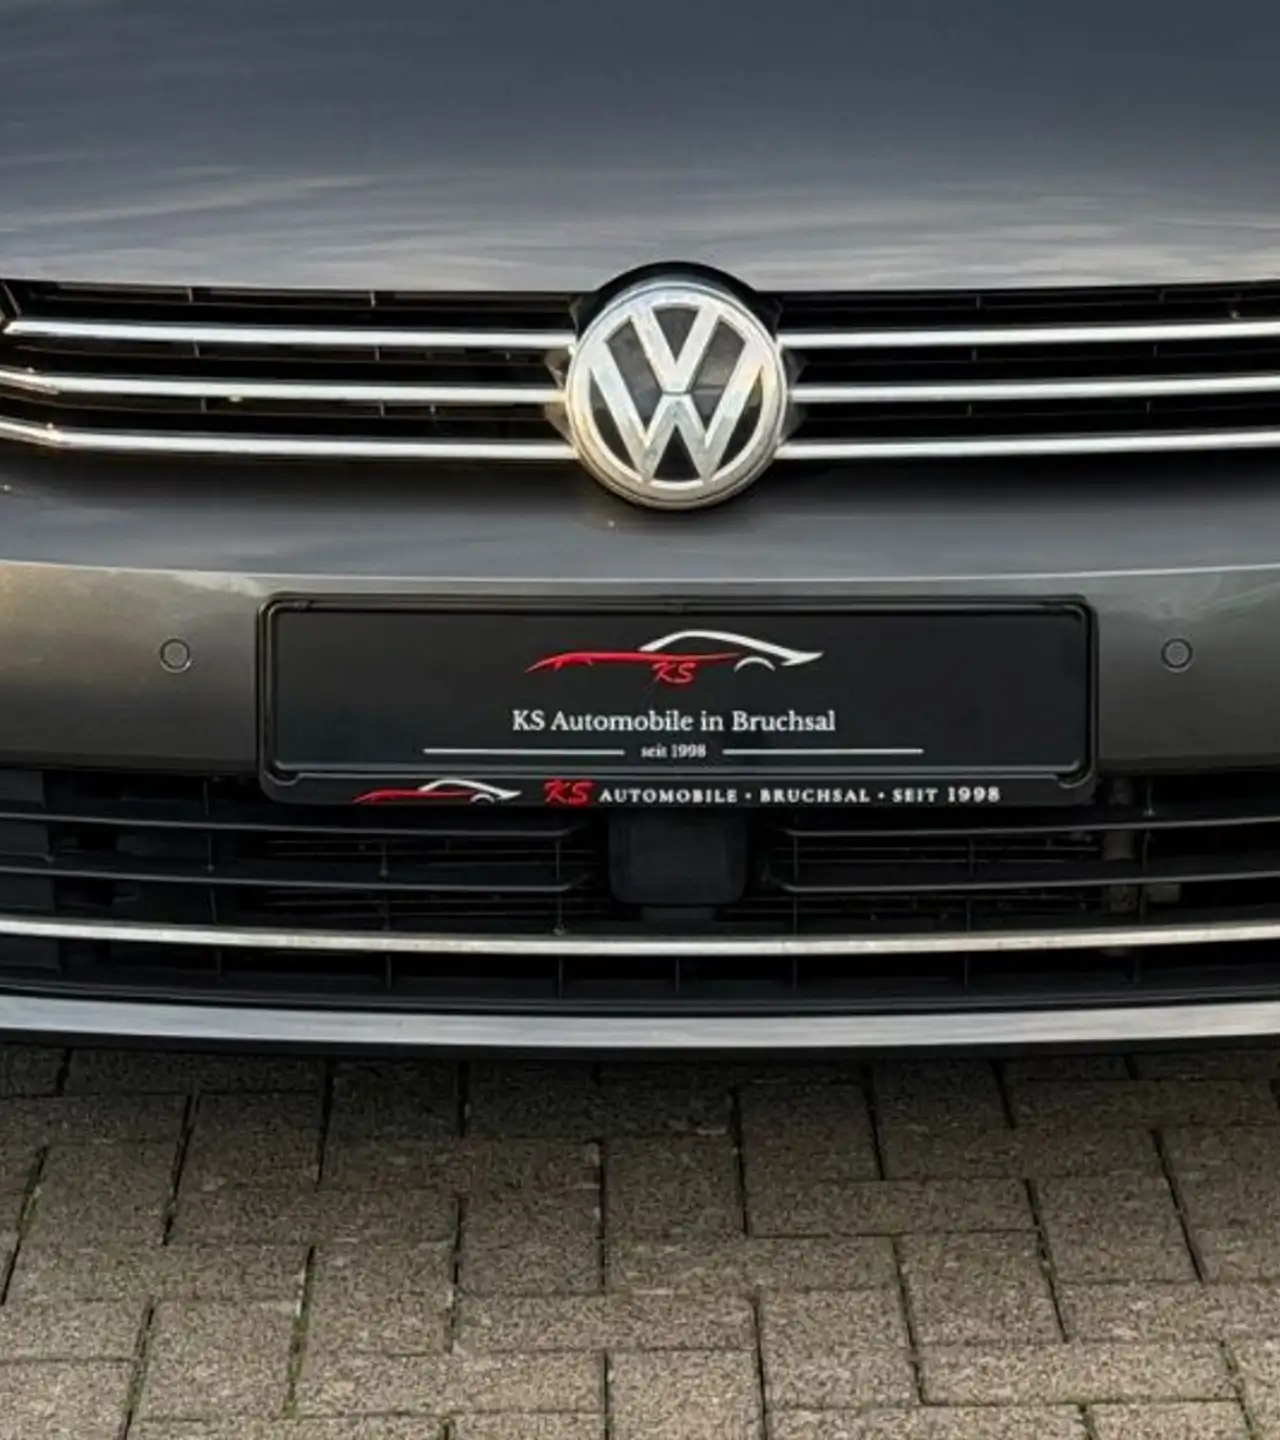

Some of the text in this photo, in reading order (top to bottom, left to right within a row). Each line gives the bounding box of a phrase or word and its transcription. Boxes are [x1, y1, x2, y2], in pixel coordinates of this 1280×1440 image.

[649, 661, 697, 685] KS
[512, 709, 837, 732] KS Automobile in Bruchsal
[640, 742, 707, 759] seit 1998
[544, 778, 1001, 804] KS AUTOMOBILE BRUCHSAL SEIT 1998
